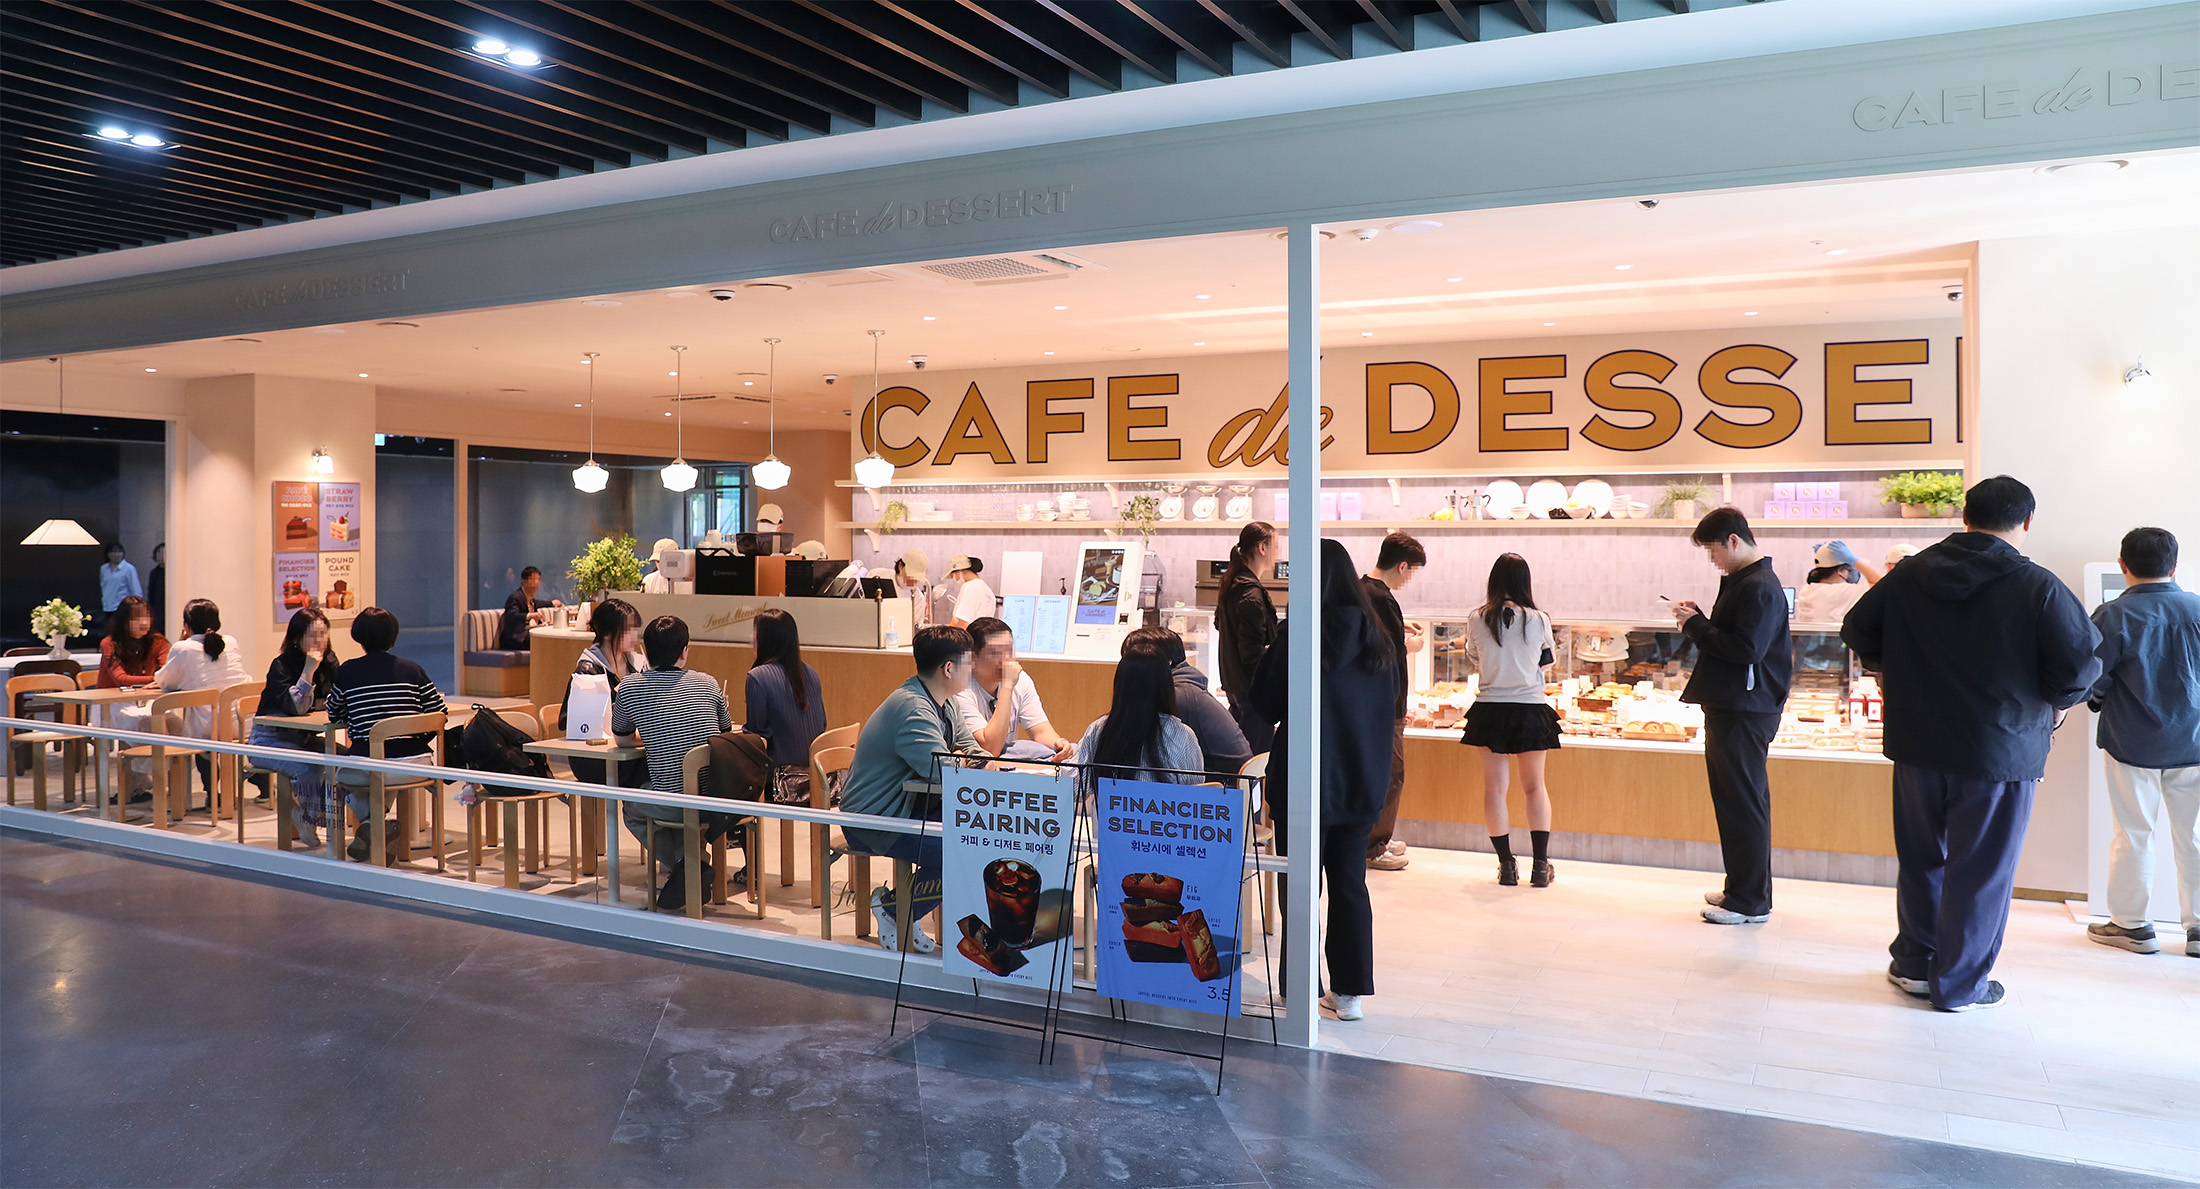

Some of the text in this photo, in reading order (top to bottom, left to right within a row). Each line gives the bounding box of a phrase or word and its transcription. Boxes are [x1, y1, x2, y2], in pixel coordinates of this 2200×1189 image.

[1852, 83, 2021, 132] CAFE
[2033, 67, 2094, 115] de
[769, 184, 1074, 244] CAFE de DESSERT
[860, 373, 1181, 469] CAFE
[1365, 336, 1964, 456] DESSE
[328, 564, 351, 572] CAKE
[957, 786, 1058, 814] COFFEE
[1109, 795, 1231, 821] FINANCIER
[955, 809, 1060, 838] PAIRING
[1108, 816, 1232, 844] SELECTION
[960, 835, 1054, 855] 커피 & 디저트 페어링
[1130, 840, 1207, 859] 휘낭시에 셀렉션
[1186, 884, 1199, 894] FIG
[1207, 986, 1230, 1002] 3.5
